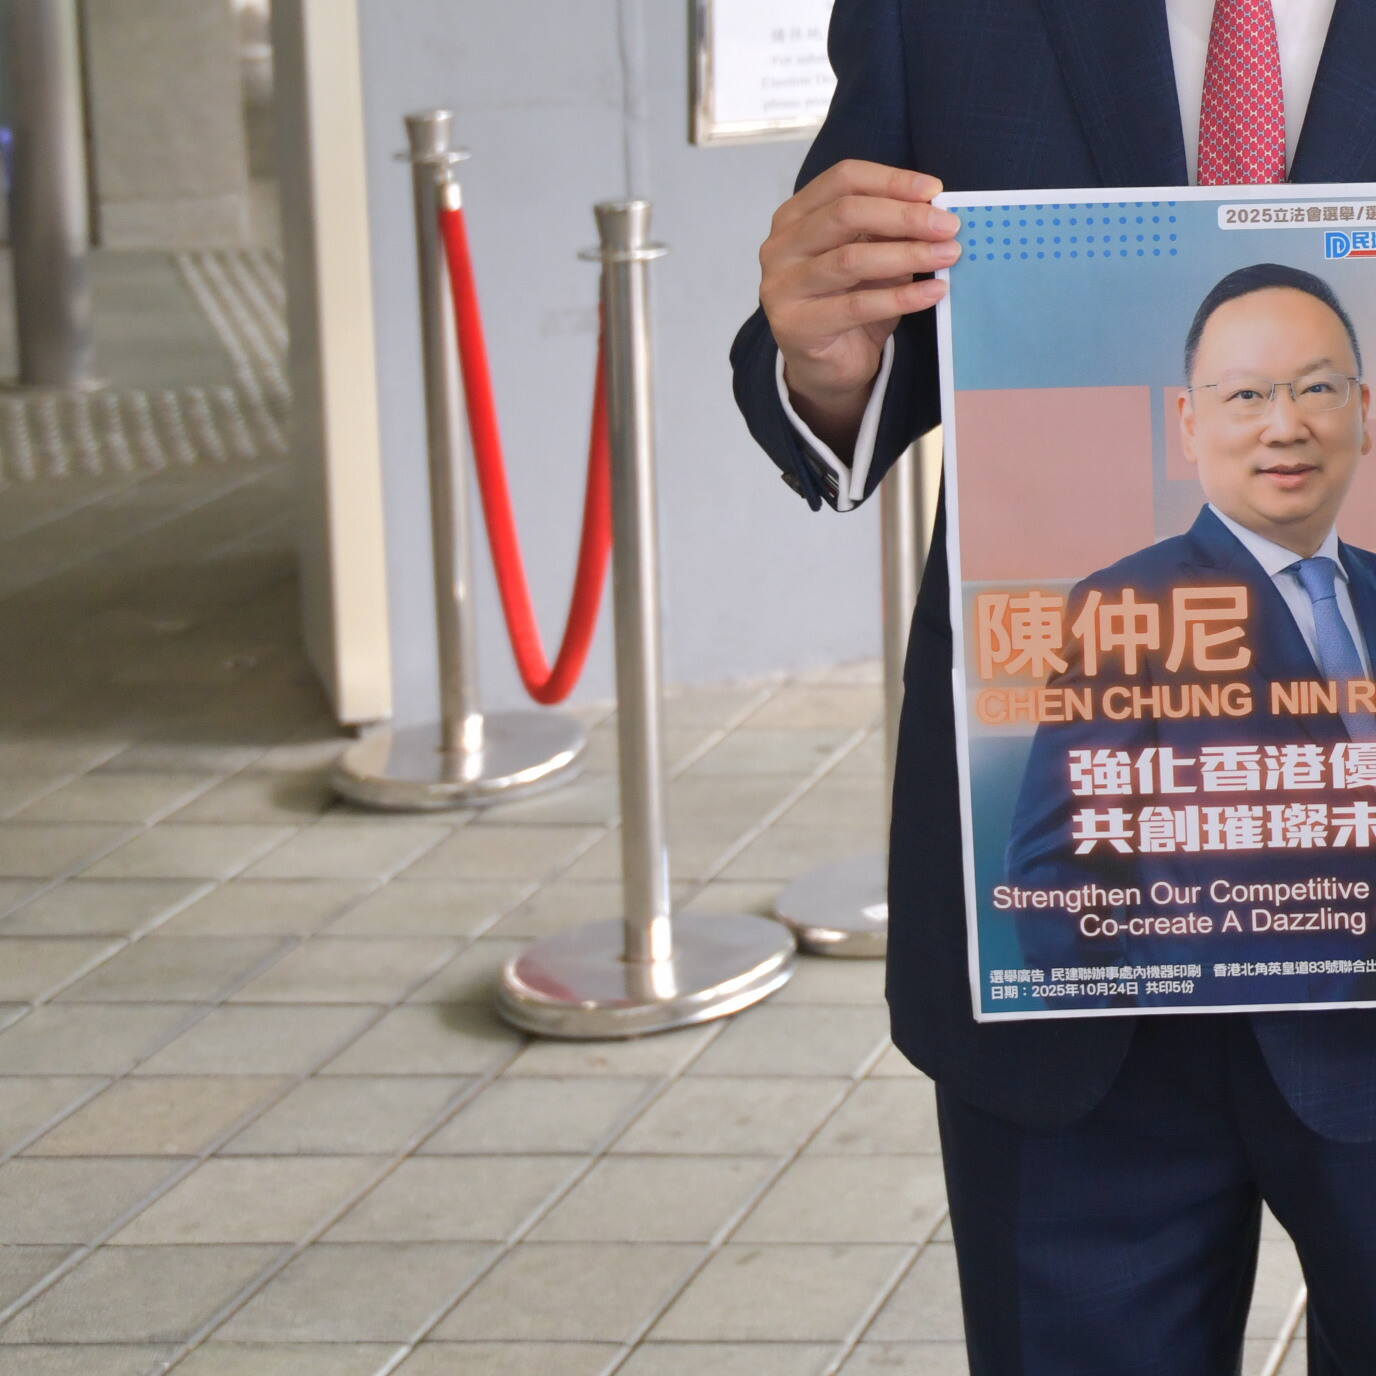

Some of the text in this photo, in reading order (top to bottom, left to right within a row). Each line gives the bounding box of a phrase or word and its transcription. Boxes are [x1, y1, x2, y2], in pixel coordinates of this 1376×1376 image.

[976, 585, 1252, 679] 陳仲尼
[977, 687, 1092, 724] CHEN
[1102, 683, 1253, 720] CHUNG
[1270, 681, 1338, 716] NIN
[992, 880, 1141, 913] Strengthen
[1150, 881, 1201, 907] Our
[1209, 877, 1370, 910] Competitive
[1079, 911, 1213, 937] Co-create
[1222, 911, 1243, 933] A
[1251, 907, 1366, 937] Dazzling
[989, 969, 1045, 985] 選舉廣告
[1145, 980, 1195, 995] 共印5份
